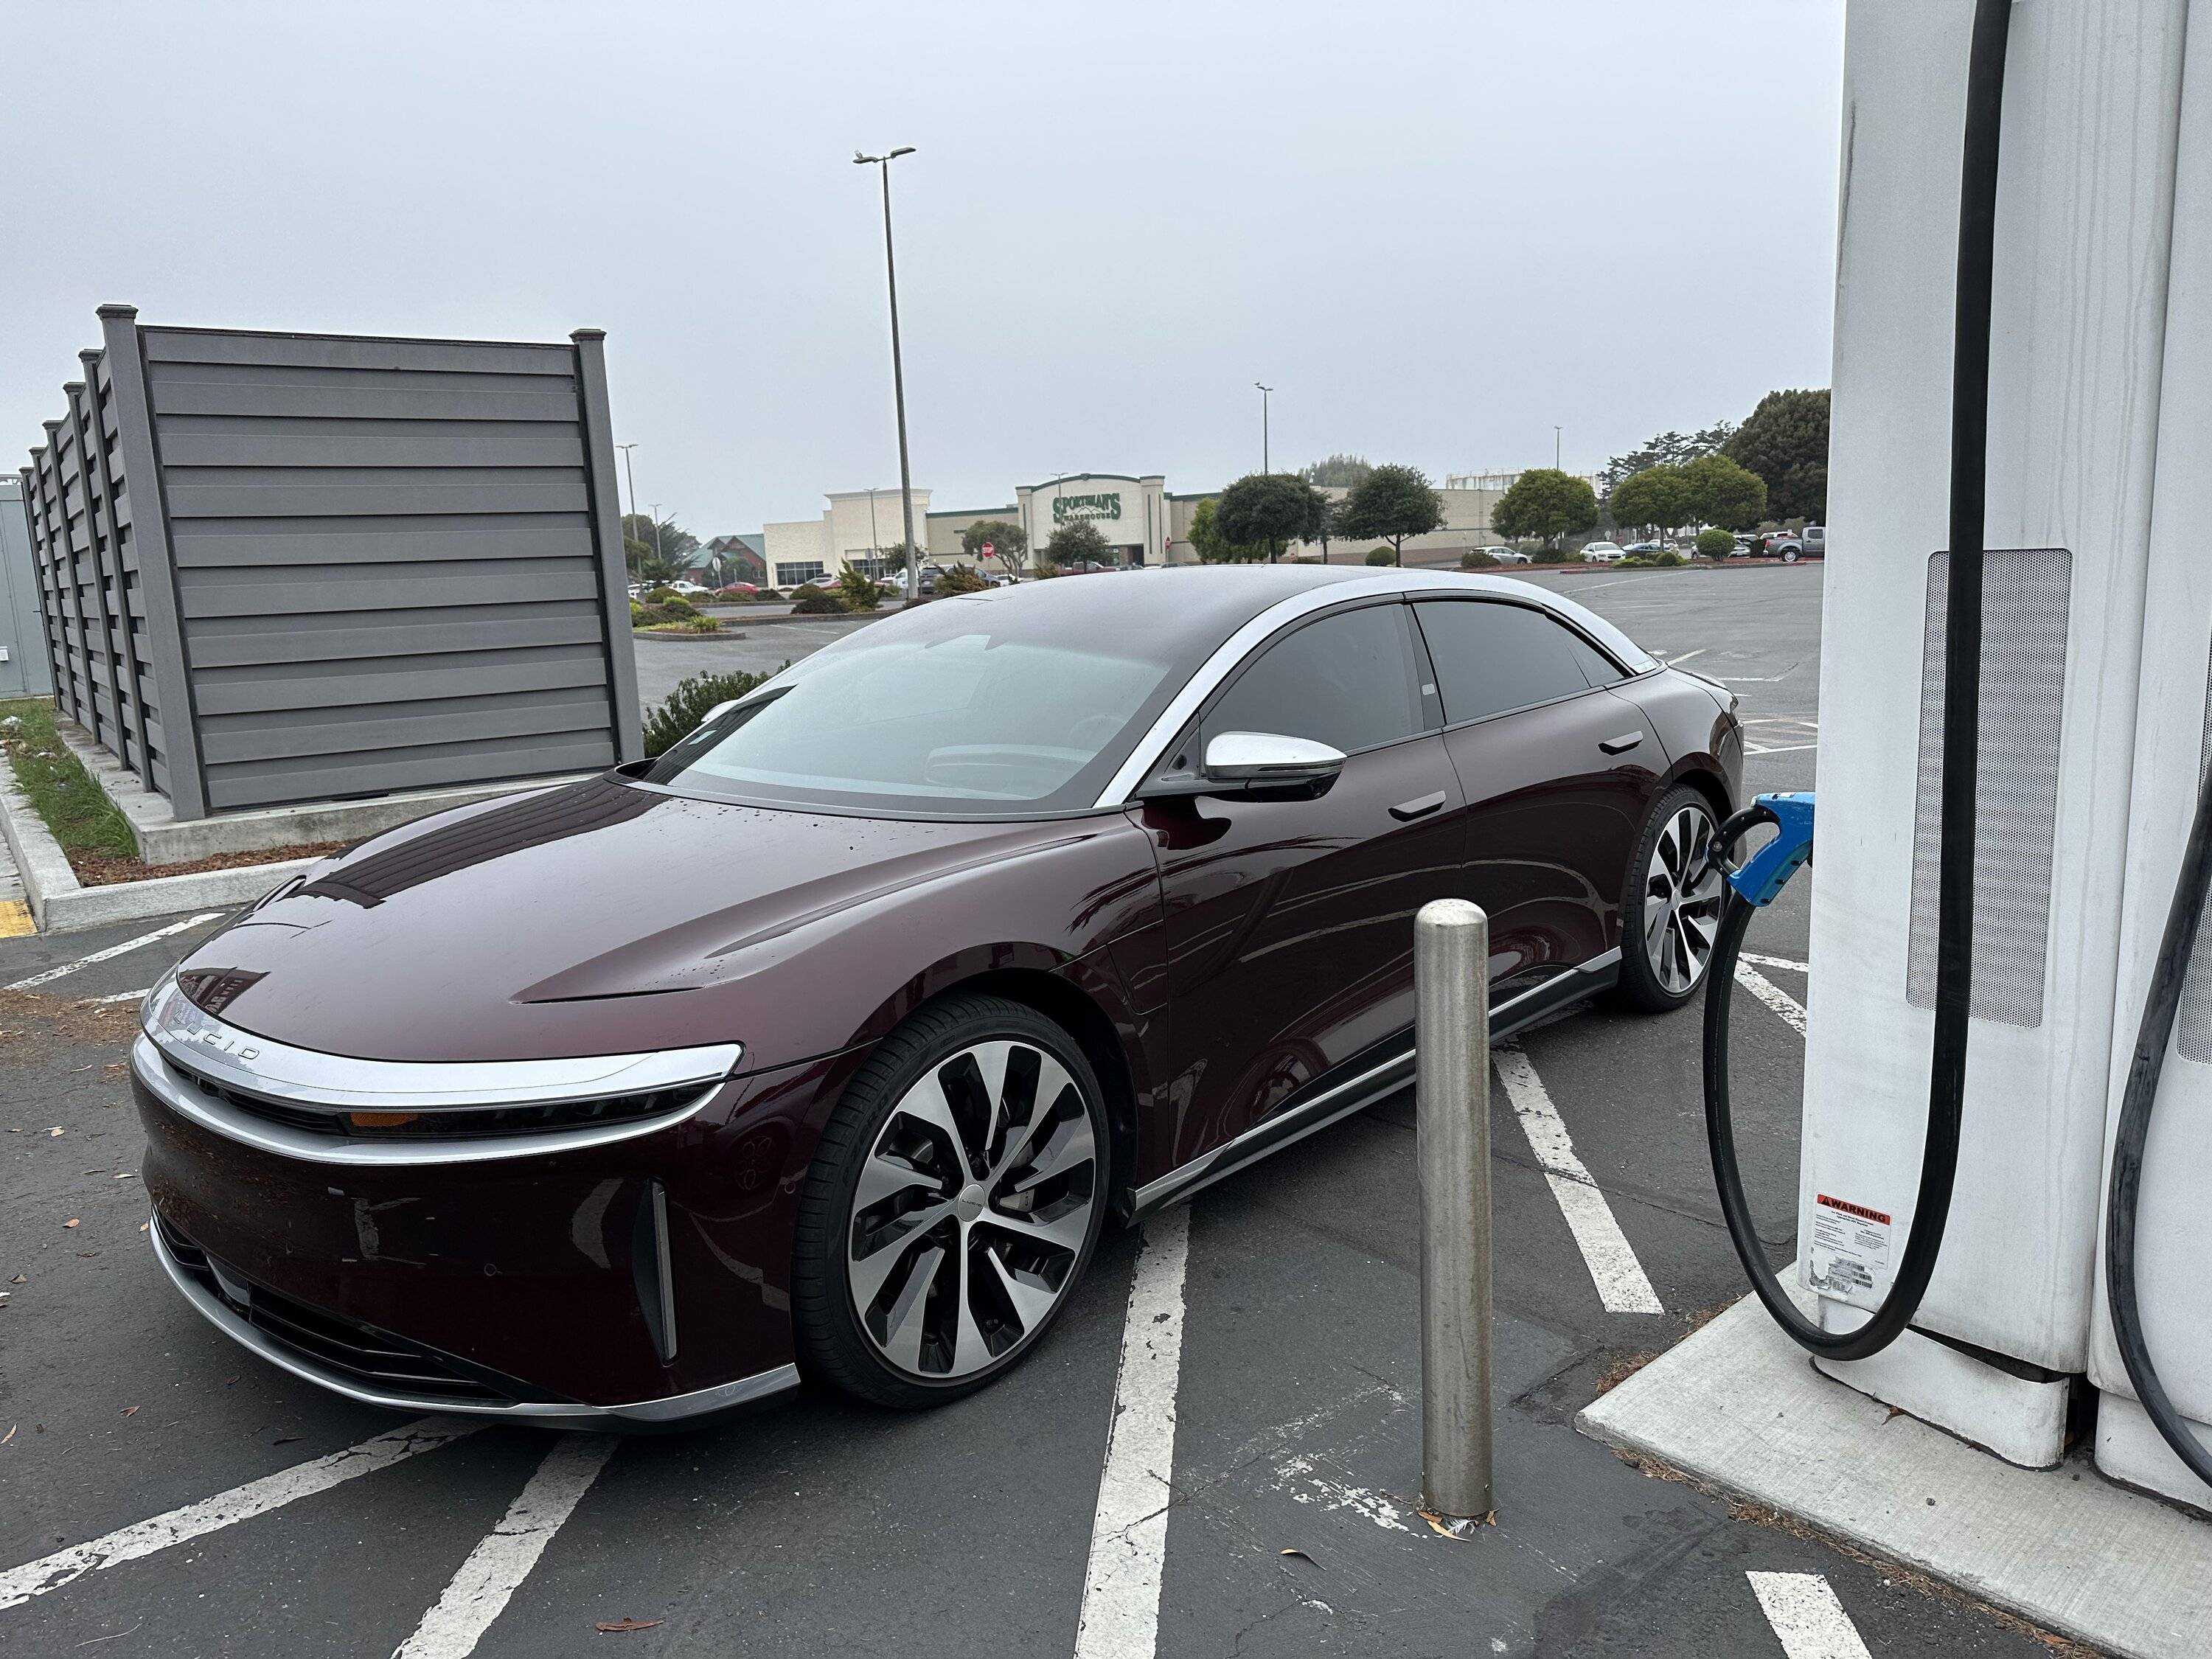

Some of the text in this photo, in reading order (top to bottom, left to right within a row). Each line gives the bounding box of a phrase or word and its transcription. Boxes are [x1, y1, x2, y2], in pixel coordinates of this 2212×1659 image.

[1053, 493, 1121, 523] SPORTSMAN'S
[1064, 512, 1110, 521] WAREHOUSE
[173, 1010, 260, 1060] LUCID
[1832, 1199, 1885, 1222] WARNING
